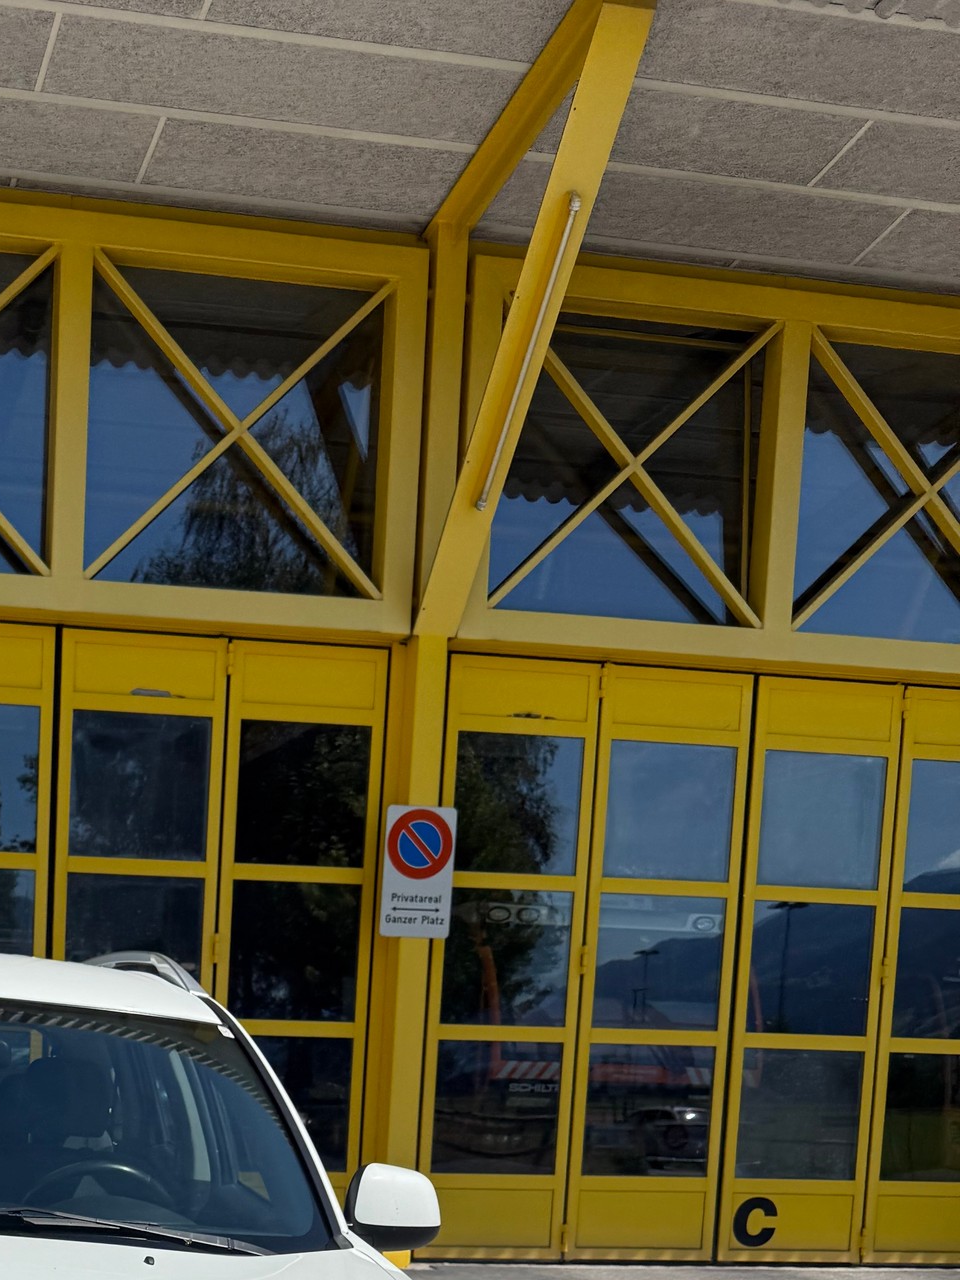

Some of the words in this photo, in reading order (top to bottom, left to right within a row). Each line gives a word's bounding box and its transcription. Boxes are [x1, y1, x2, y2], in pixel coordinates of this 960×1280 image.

[390, 892, 442, 904] Privatareal
[384, 914, 418, 925] Ganzer
[421, 915, 445, 926] Platz
[733, 1197, 778, 1247] C
